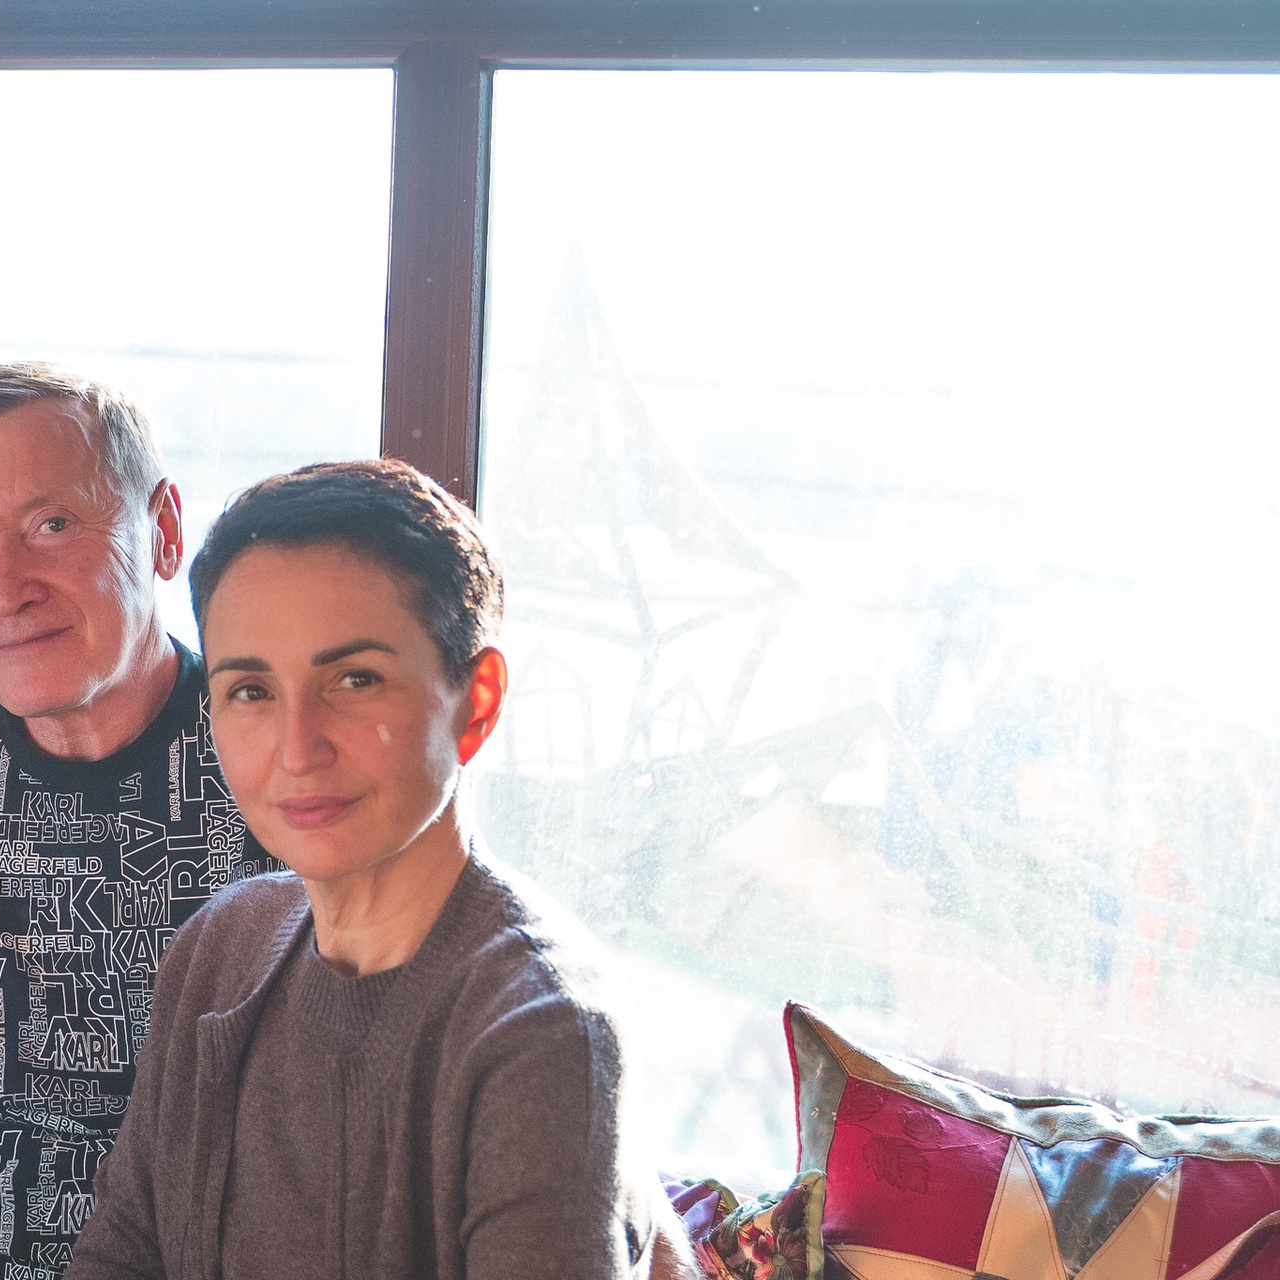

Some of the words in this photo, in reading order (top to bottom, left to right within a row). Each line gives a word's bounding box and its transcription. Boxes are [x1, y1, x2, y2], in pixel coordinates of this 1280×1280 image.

[22, 791, 93, 822] KARL
[27, 964, 50, 1069] LAGERFELD
[19, 1016, 35, 1064] KARL
[54, 1031, 123, 1072] KARL
[25, 1073, 111, 1100] KARL
[27, 1182, 43, 1231] KARL
